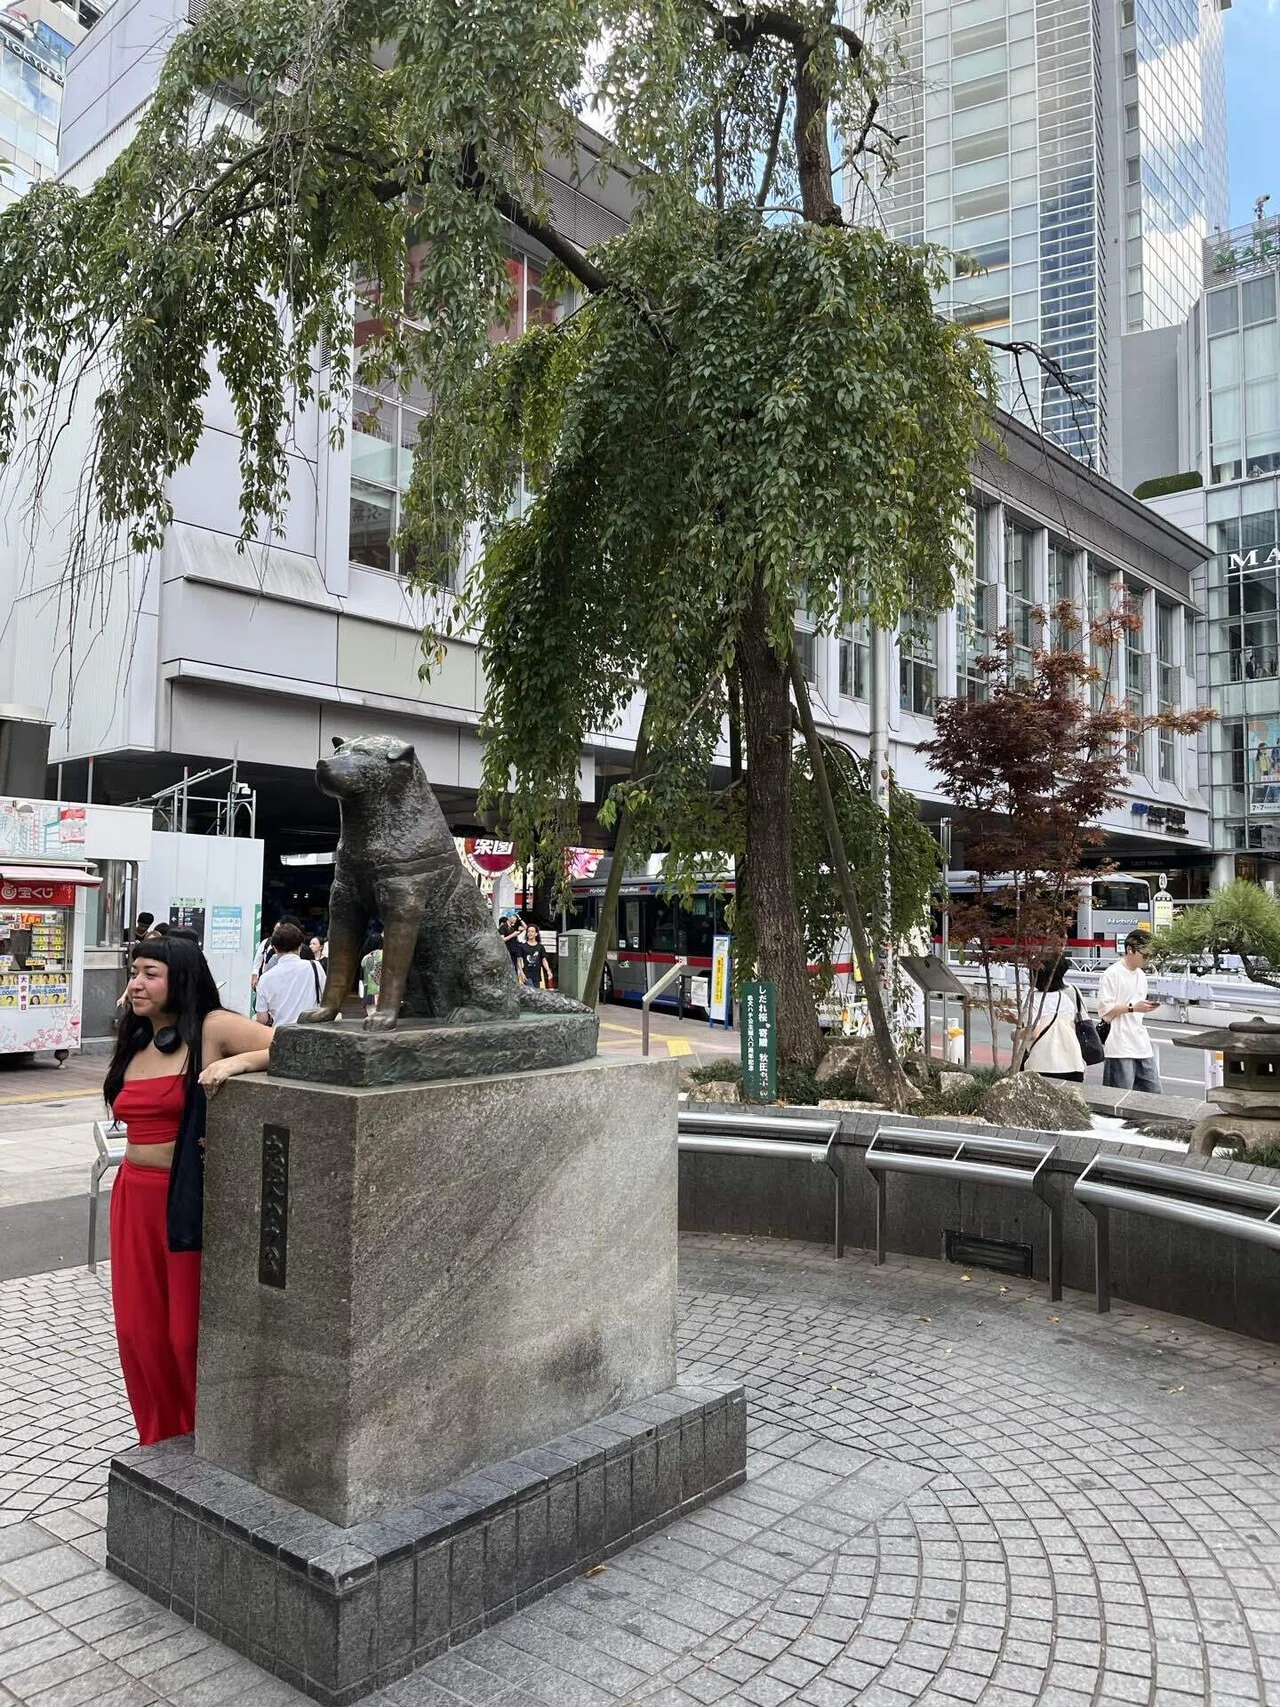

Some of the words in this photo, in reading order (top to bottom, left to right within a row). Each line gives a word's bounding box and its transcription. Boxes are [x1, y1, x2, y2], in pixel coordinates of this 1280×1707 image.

[5, 37, 50, 76] TOKYU
[18, 886, 53, 899] 宝くじ
[20, 976, 28, 1010] 大安吉日
[758, 985, 768, 1022] しだれ桜
